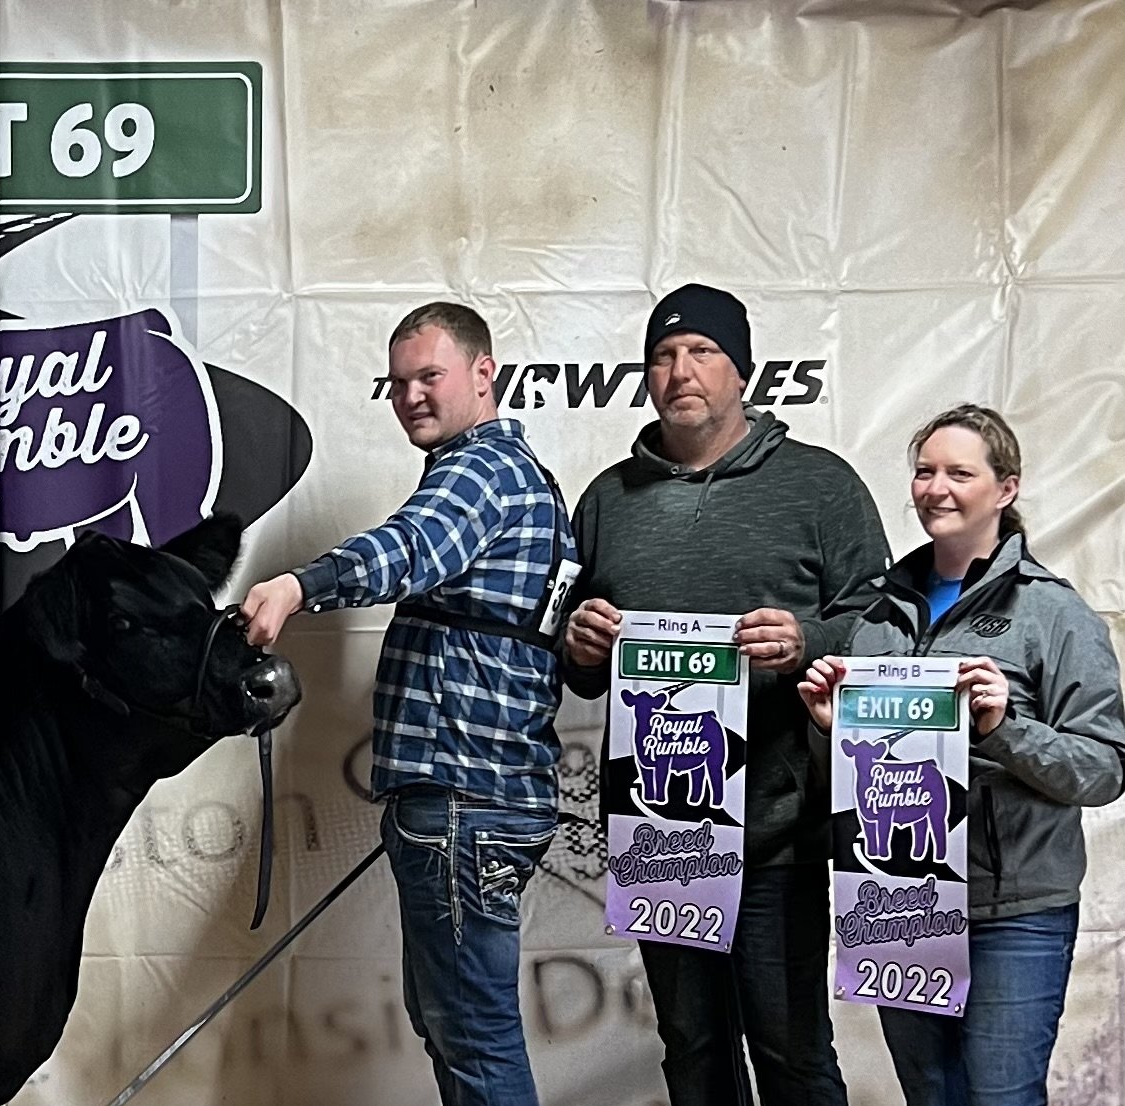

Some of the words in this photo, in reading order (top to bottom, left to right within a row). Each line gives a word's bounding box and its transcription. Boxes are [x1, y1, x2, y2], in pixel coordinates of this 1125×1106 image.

[50, 102, 155, 179] 69
[658, 618, 688, 635] Ring
[691, 619, 702, 633] A
[637, 649, 685, 673] EXIT
[688, 651, 716, 674] 69
[878, 664, 908, 680] Ring
[911, 665, 921, 678] B
[857, 695, 904, 719] EXIT
[907, 697, 934, 720] 69
[649, 714, 704, 741] Royal
[643, 735, 711, 762] Rumble
[870, 764, 925, 792] Royal
[864, 786, 934, 815] Rumble
[629, 820, 714, 858] Breed
[608, 851, 743, 887] Champion
[854, 877, 939, 917] Breed
[625, 897, 724, 944] 2022
[835, 909, 968, 948] Champion
[853, 958, 954, 1007] 2022
